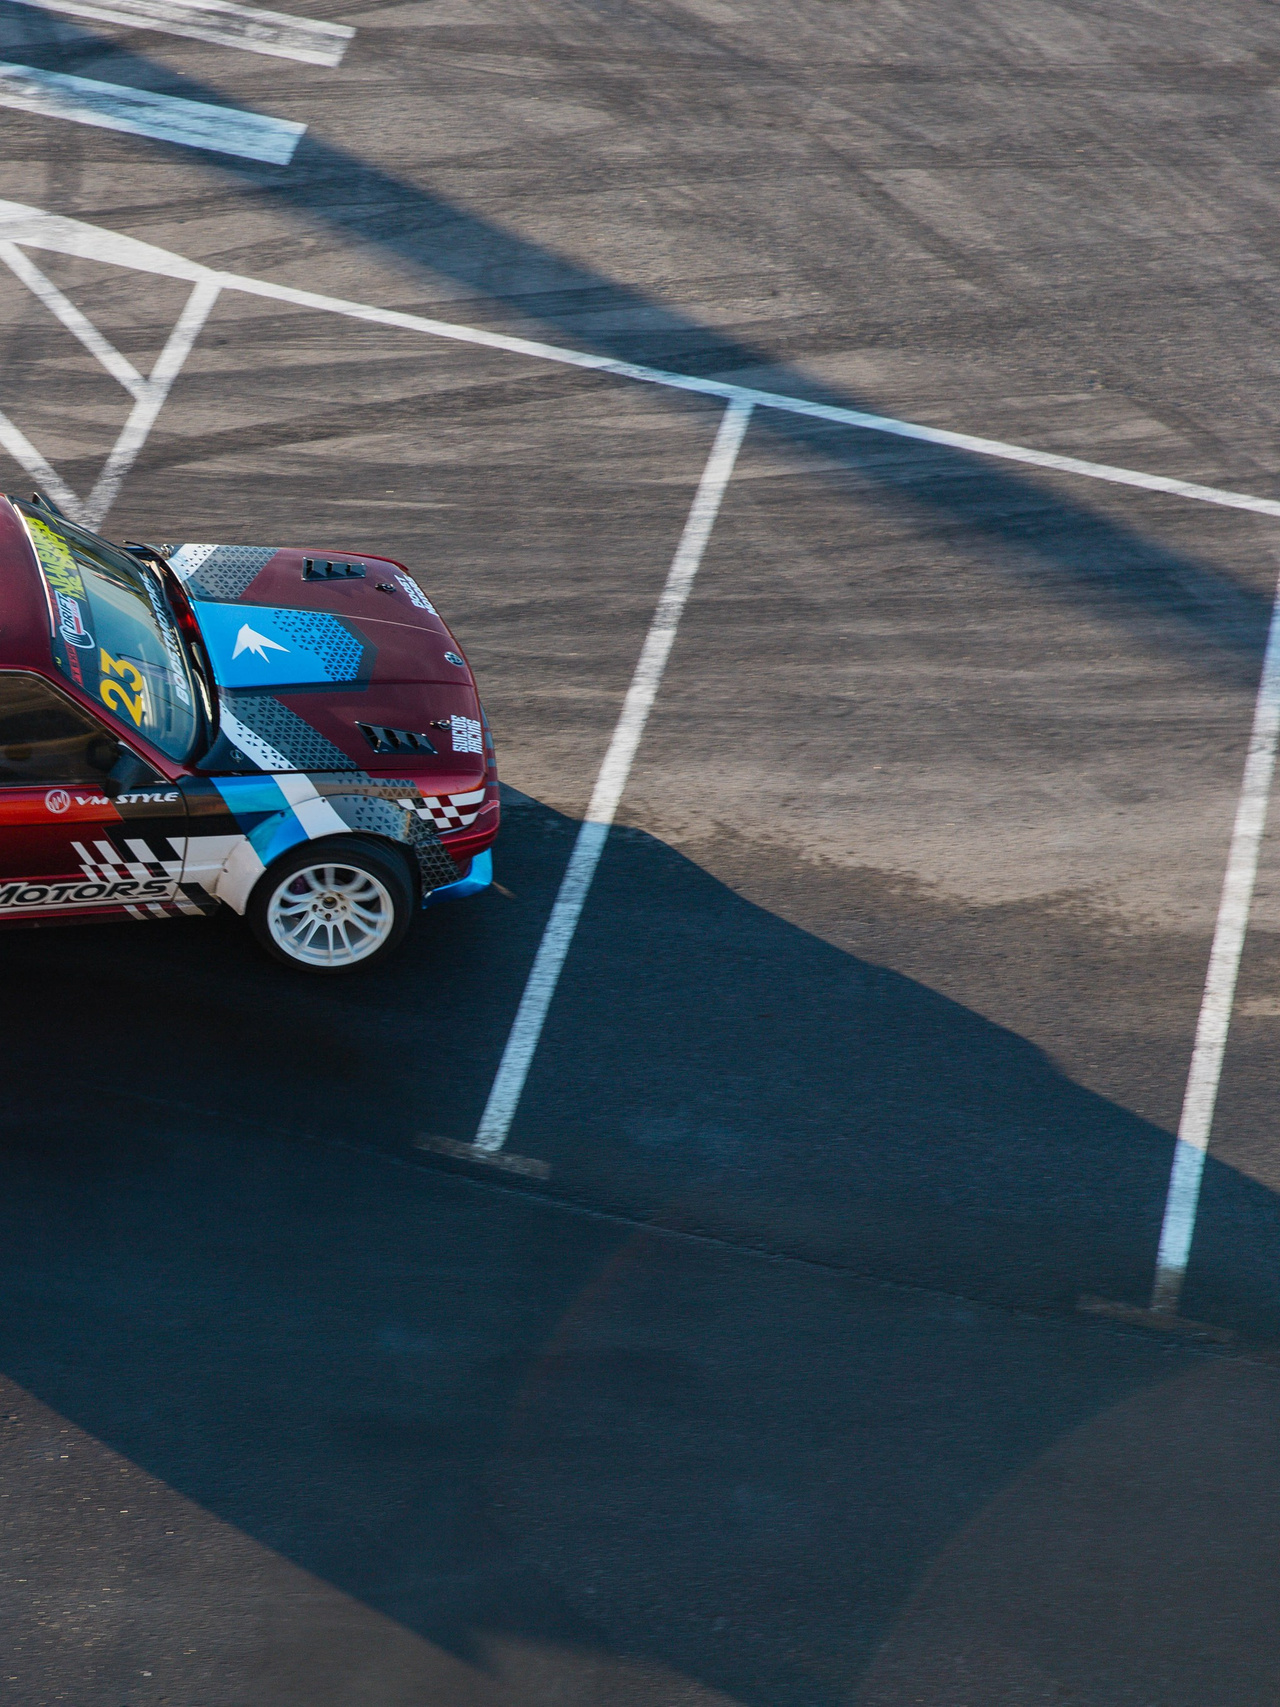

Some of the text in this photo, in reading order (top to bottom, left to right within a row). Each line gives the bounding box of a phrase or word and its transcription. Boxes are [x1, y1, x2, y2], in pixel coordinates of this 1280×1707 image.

[58, 592, 74, 627] DRIFT
[394, 574, 426, 609] BOOST
[403, 574, 439, 617] MOTORS
[100, 647, 144, 727] 23
[451, 714, 468, 753] SUICIDE
[467, 718, 483, 754] RACING
[75, 792, 179, 806] VM STYLE
